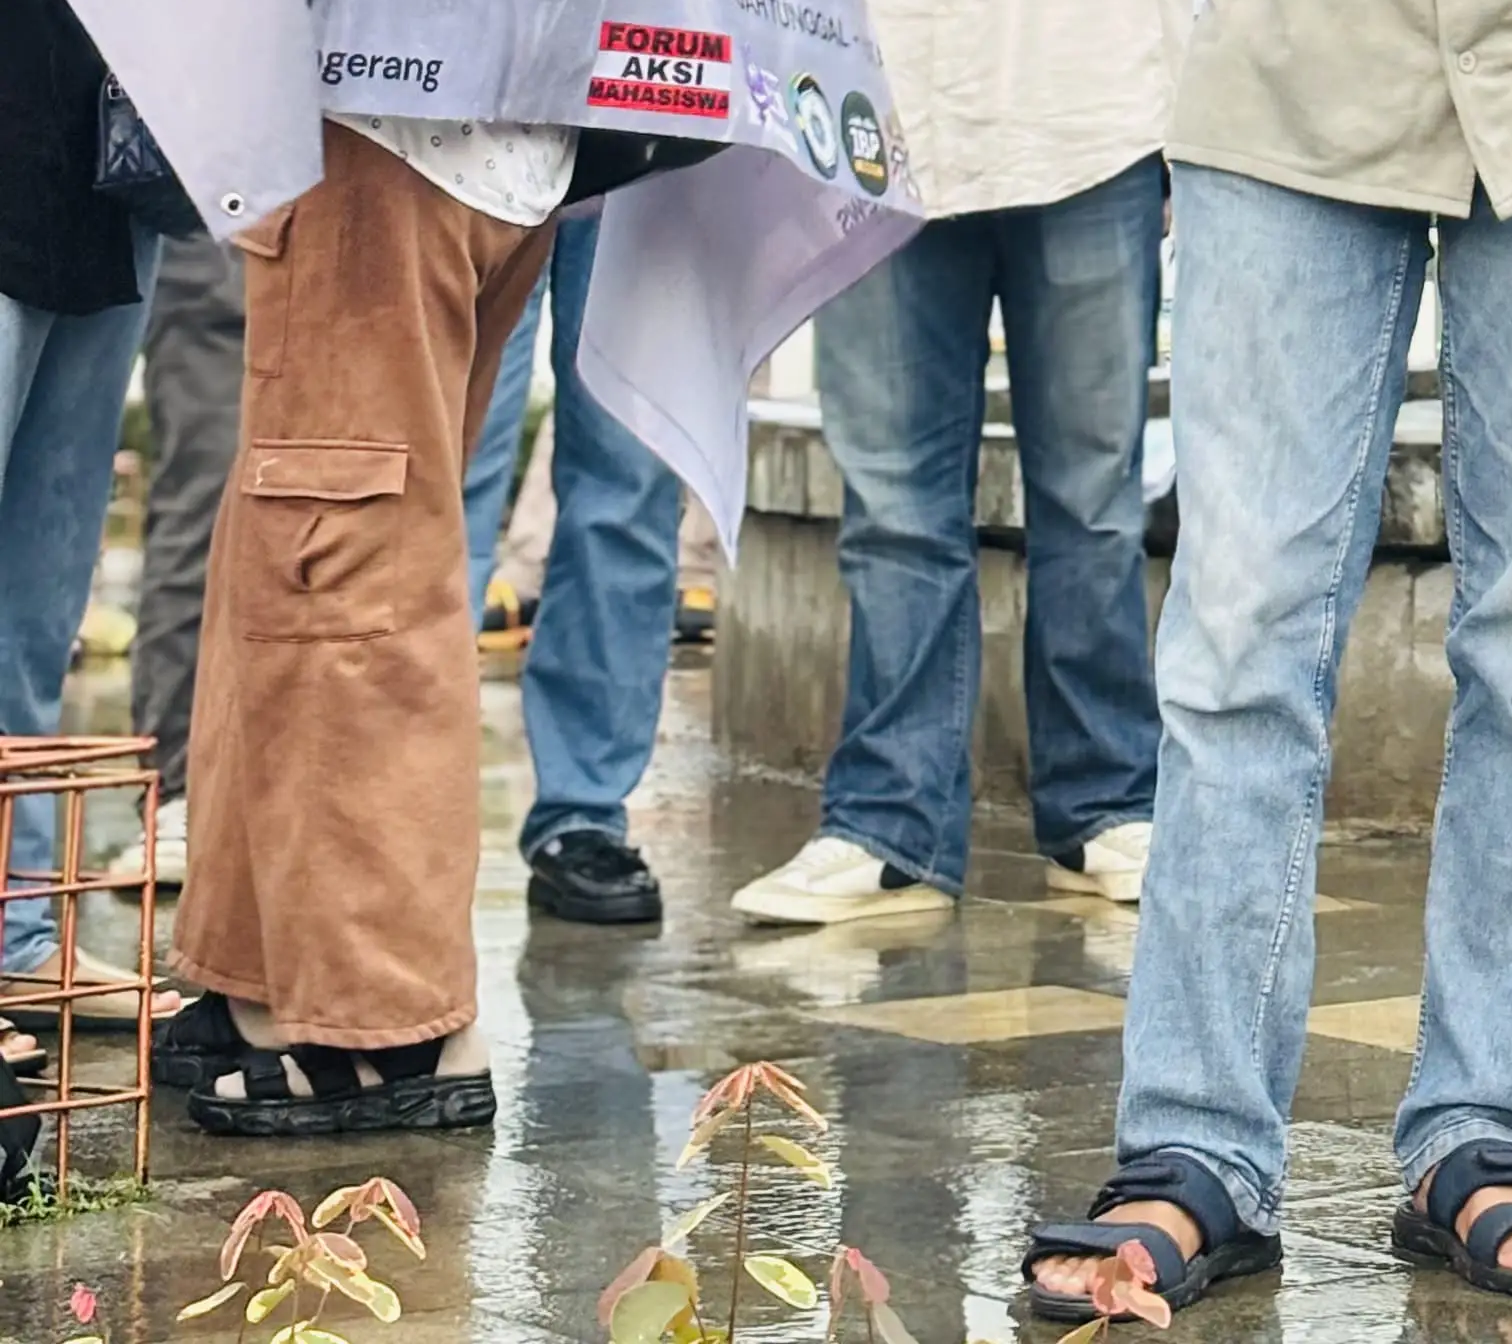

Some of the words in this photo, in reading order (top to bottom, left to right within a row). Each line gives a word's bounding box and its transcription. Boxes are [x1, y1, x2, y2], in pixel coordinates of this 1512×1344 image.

[607, 24, 724, 58] FORUM
[318, 49, 443, 92] gerang
[621, 56, 703, 86] AKSI
[588, 80, 729, 111] MAHASISWA
